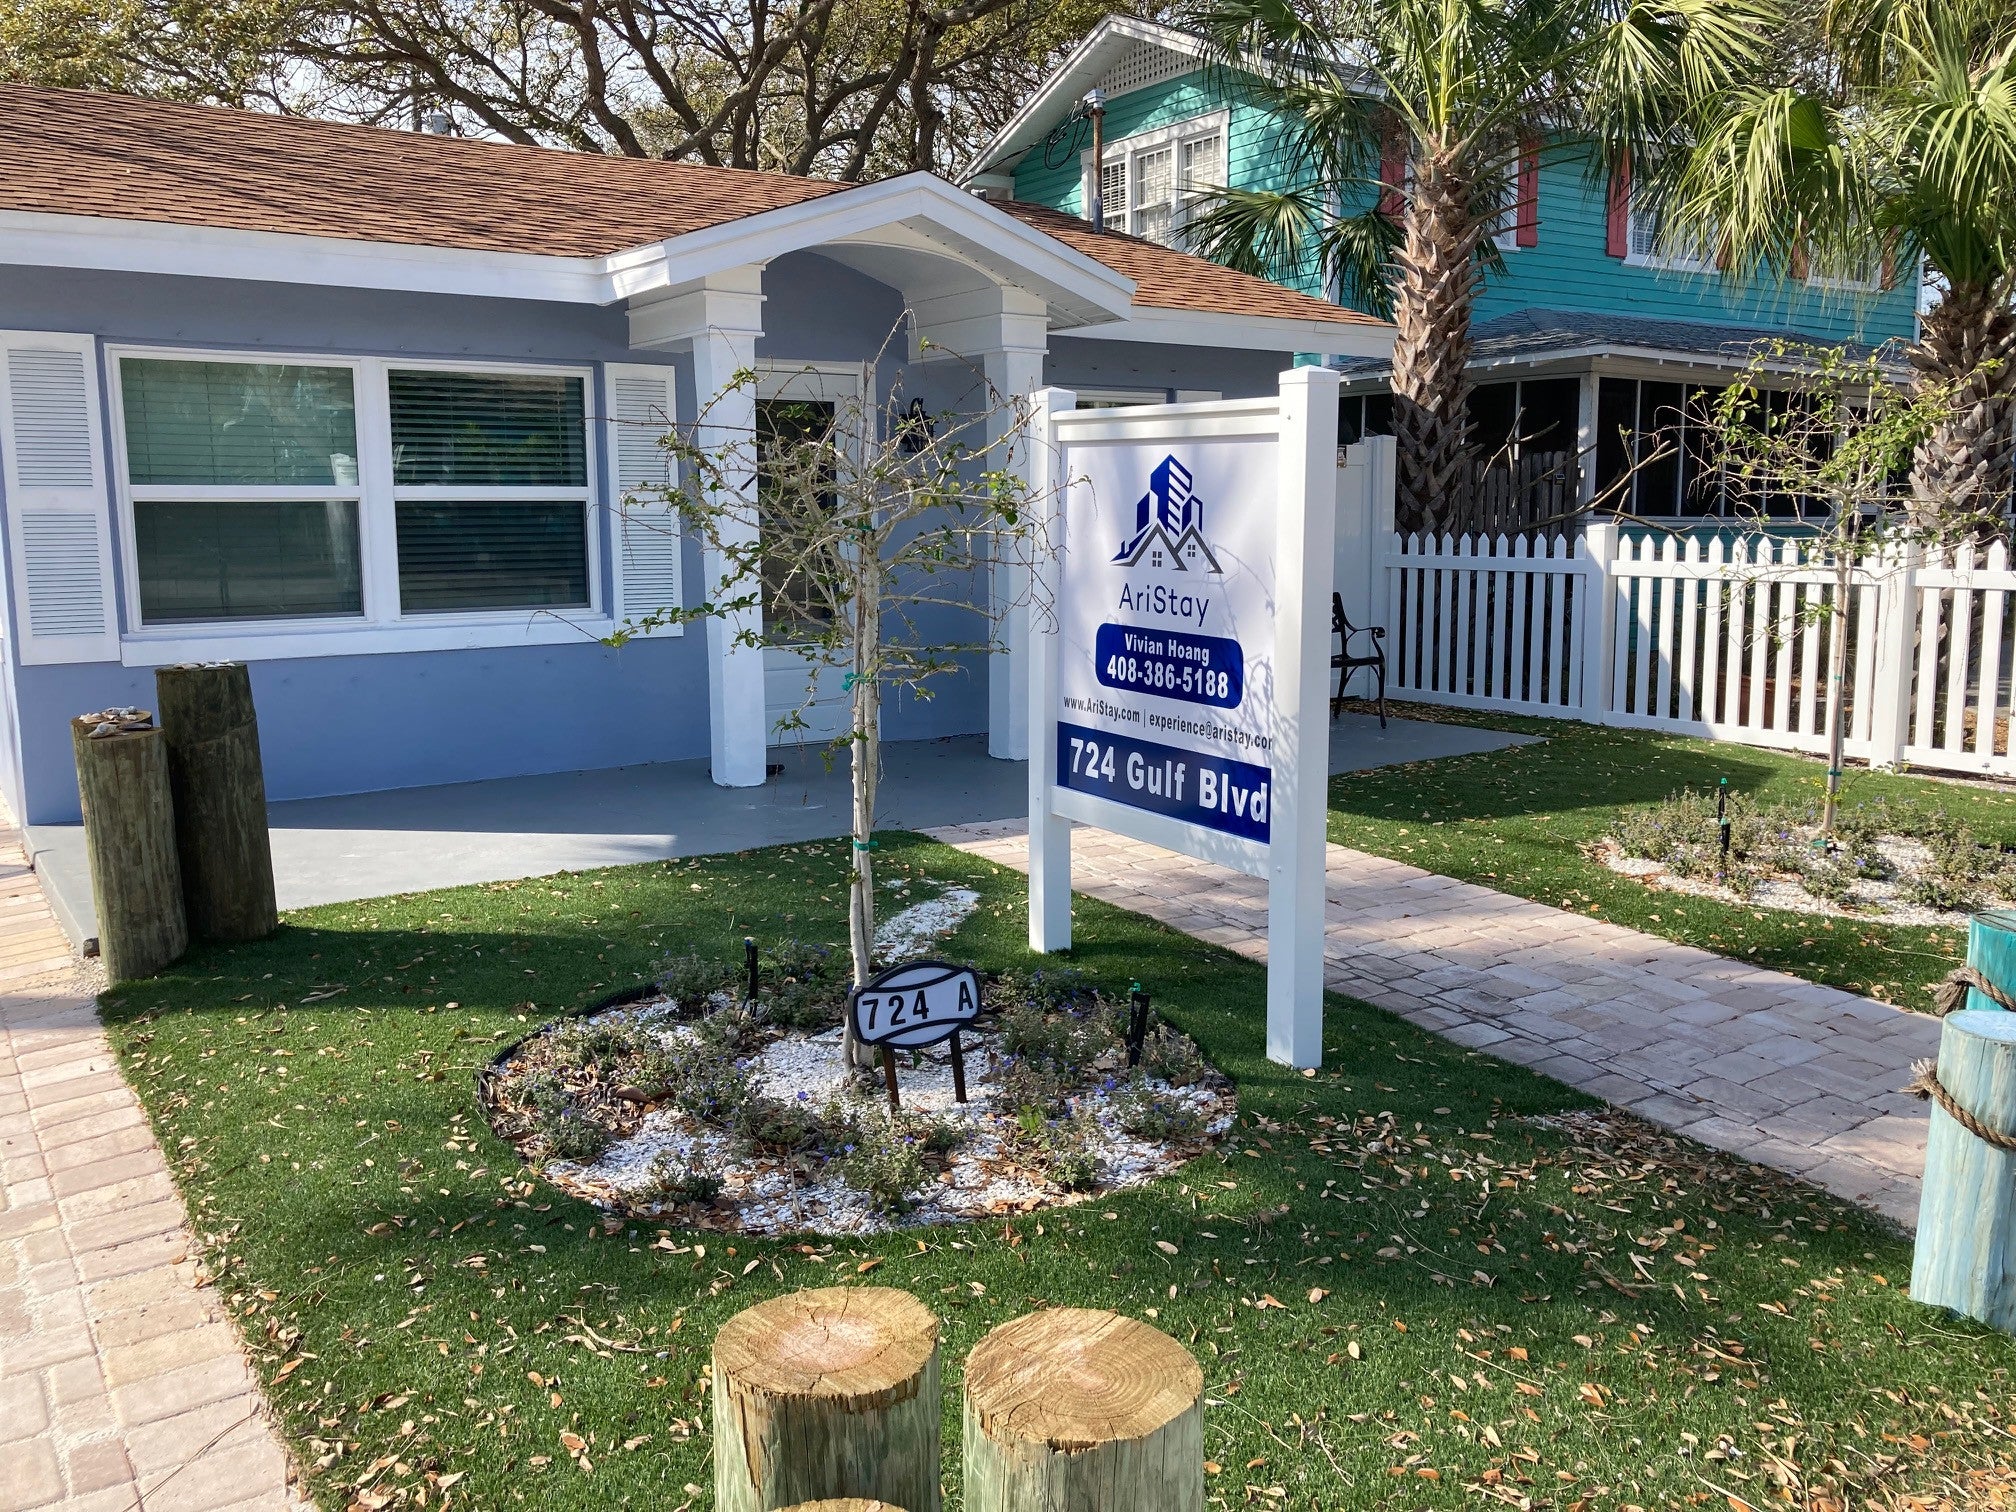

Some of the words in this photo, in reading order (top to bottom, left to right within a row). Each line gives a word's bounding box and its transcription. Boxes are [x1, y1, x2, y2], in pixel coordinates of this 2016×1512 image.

[1118, 582, 1210, 627] AriStay
[1124, 633, 1163, 656] Vivian
[1168, 639, 1210, 667] Hoang
[1106, 654, 1229, 699] 408-386-5188
[1063, 697, 1140, 723] www.AriStay.com
[1070, 737, 1116, 783] 724
[1126, 752, 1186, 801] Gulf
[1199, 767, 1268, 824] Blvd
[862, 989, 930, 1030] 724
[958, 980, 974, 1012] A
